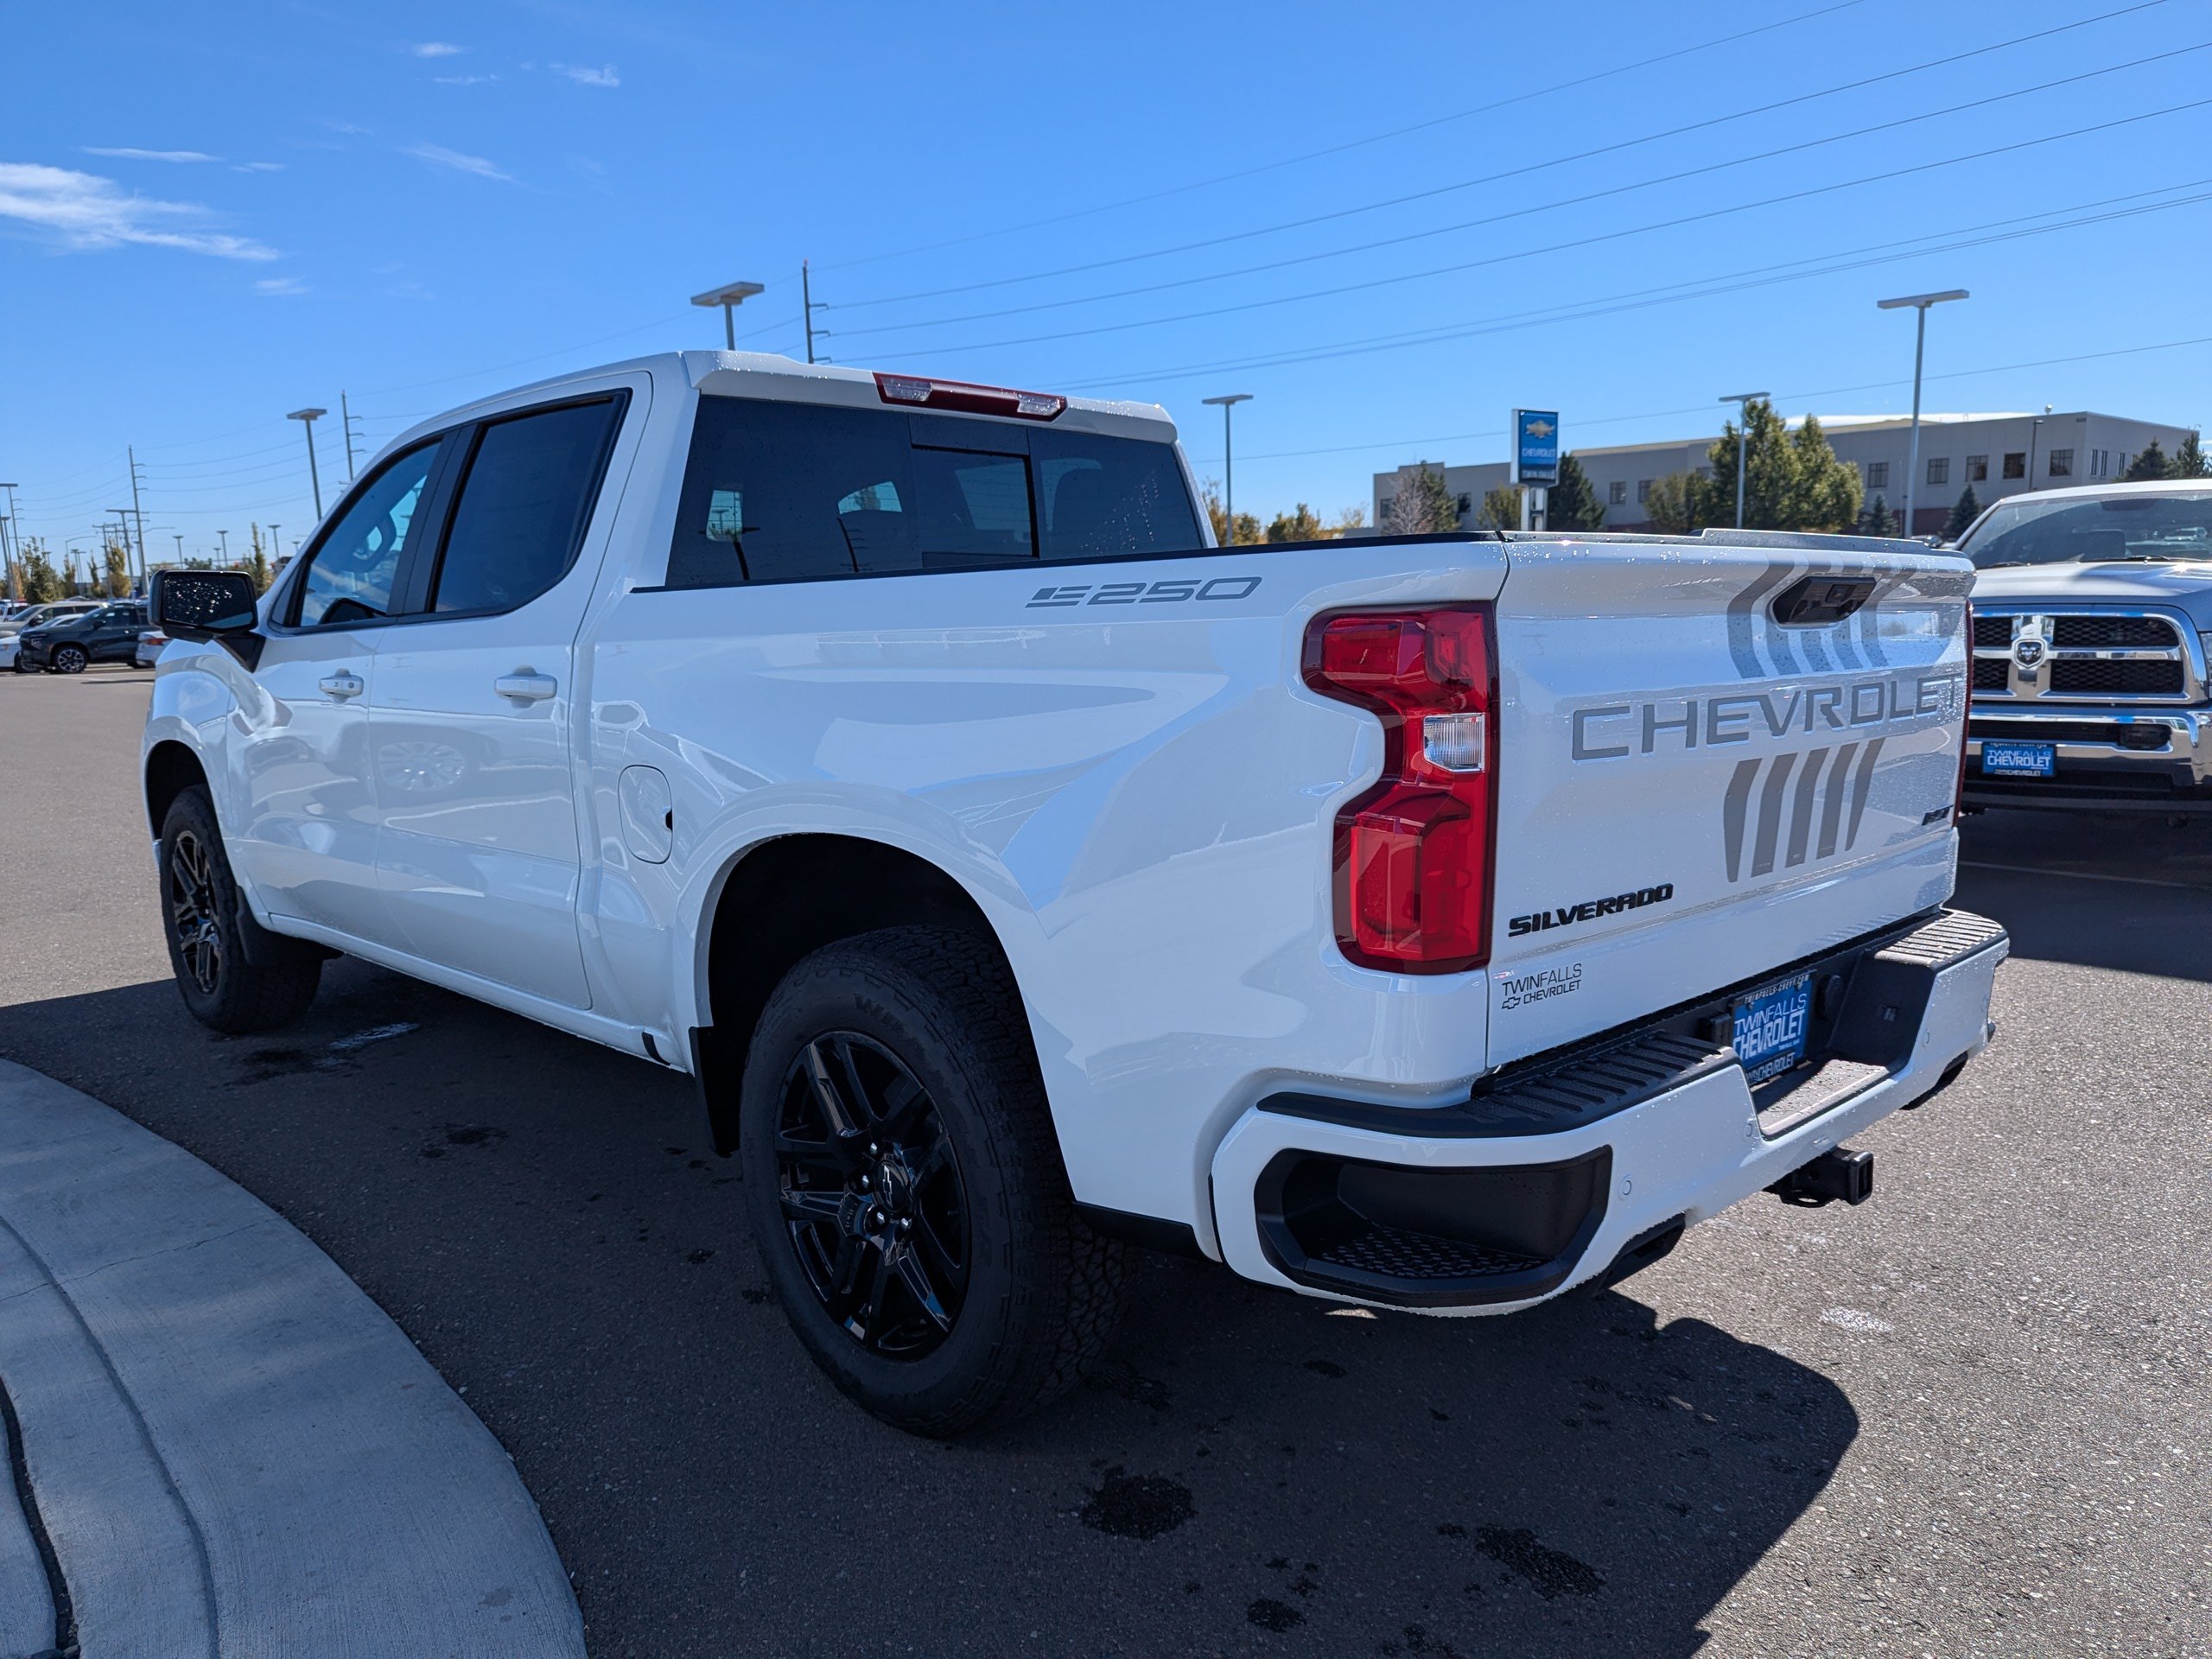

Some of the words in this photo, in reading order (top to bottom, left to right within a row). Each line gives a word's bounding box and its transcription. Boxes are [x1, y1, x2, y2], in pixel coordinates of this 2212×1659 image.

[1522, 448, 1555, 458] CHEVROLET
[1572, 671, 1963, 761] CHEVROLET
[1986, 756, 2051, 767] CHEVROLET
[1508, 883, 1674, 938] SILVERADO
[1502, 963, 1582, 996] TWINFALLS
[1523, 979, 1581, 1004] CHEVROLET
[1734, 993, 1808, 1037] TWINFALLS
[1732, 1009, 1805, 1060] CHEVROLET
